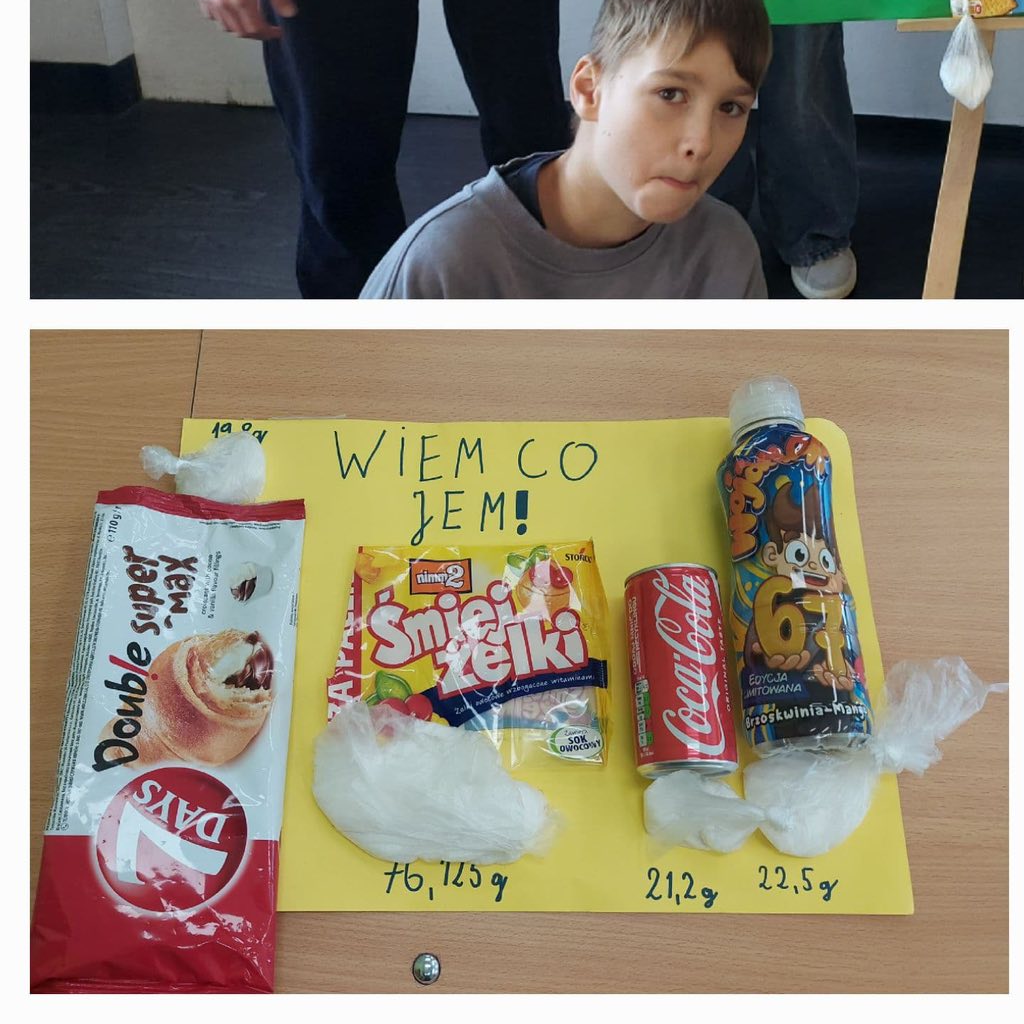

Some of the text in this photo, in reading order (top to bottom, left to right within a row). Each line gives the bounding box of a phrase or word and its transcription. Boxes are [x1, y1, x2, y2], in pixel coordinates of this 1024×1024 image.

[518, 438, 598, 481] CO
[410, 490, 529, 546] JEM!
[122, 545, 165, 636] super
[416, 563, 465, 589] nimm2
[367, 580, 517, 668] Śmiej
[748, 673, 788, 686] EDYCJA
[559, 739, 601, 753] OWOCOWY
[568, 735, 588, 744] SOK
[133, 779, 230, 844] DAYS
[116, 801, 228, 886] 7
